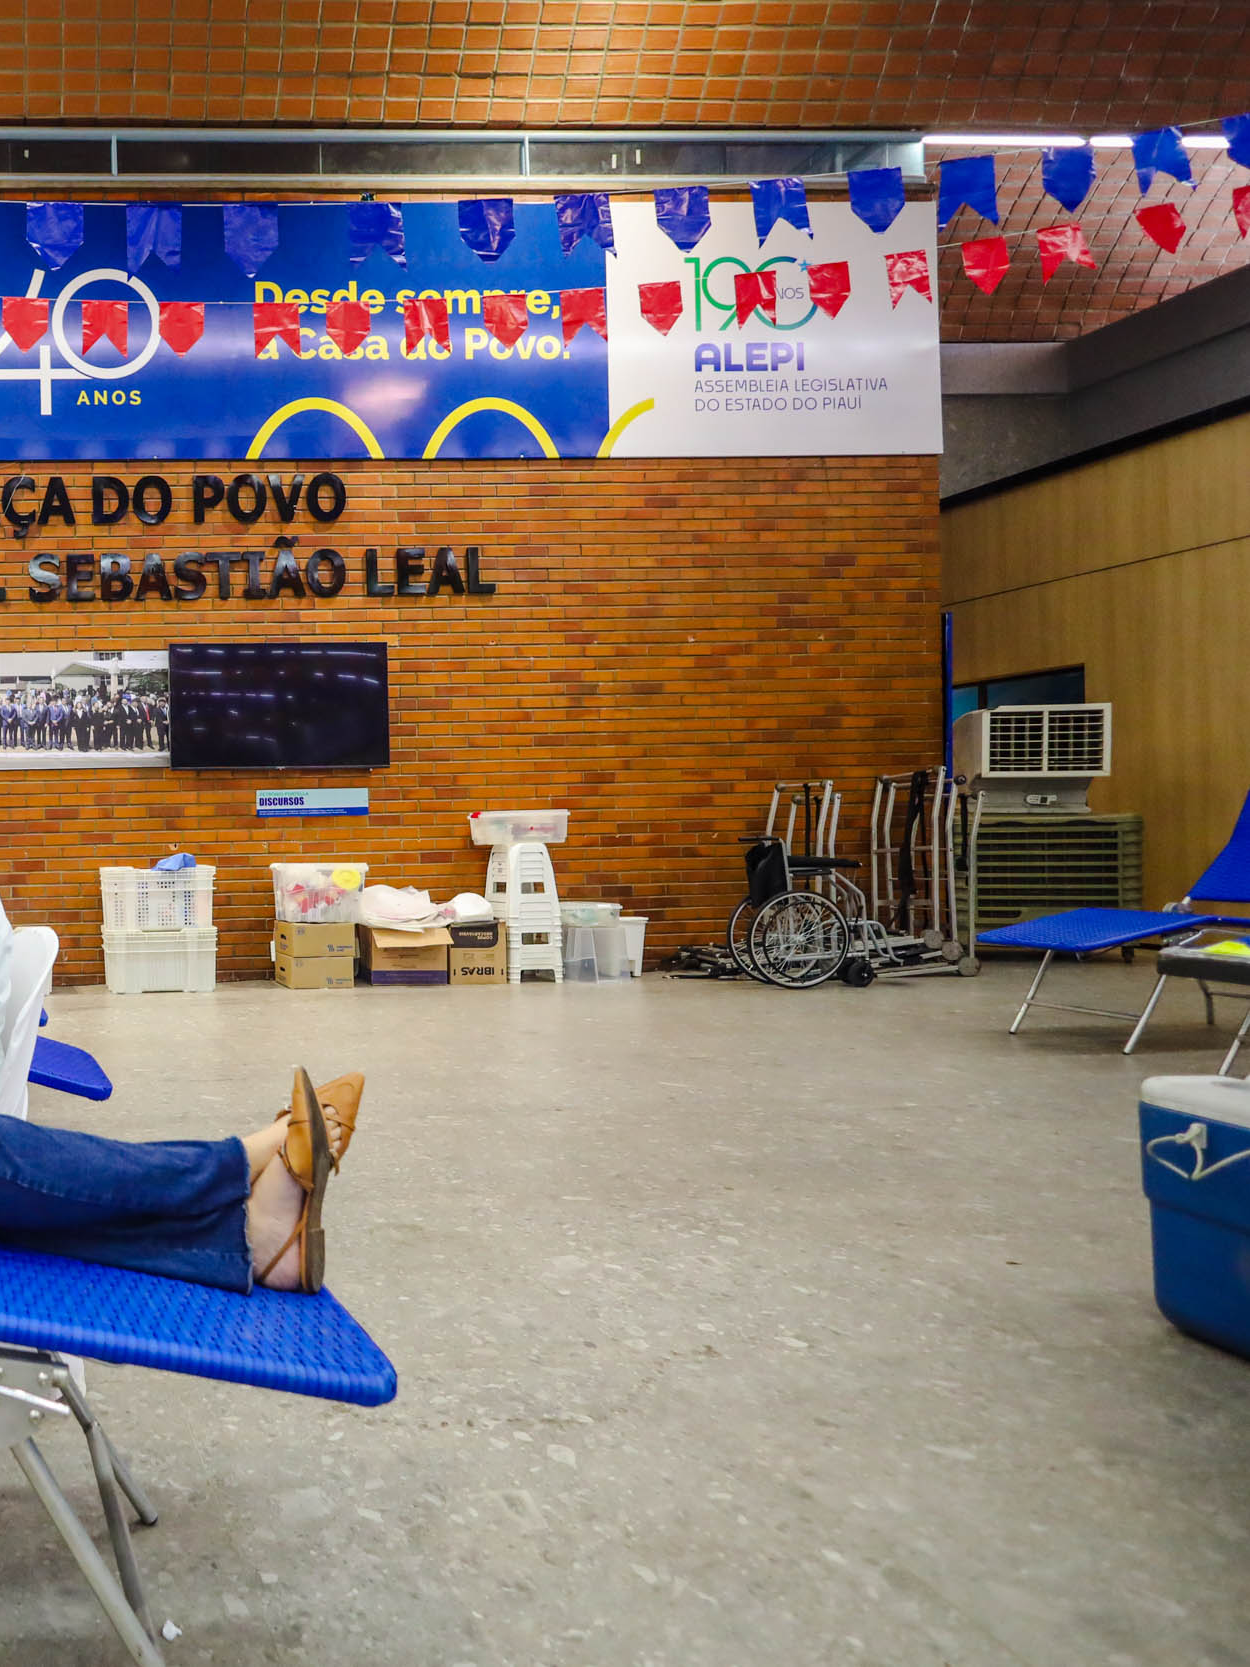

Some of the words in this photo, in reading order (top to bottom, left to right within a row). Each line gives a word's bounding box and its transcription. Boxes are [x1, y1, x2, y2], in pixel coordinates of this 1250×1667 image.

[464, 327, 571, 361] Povo.
[694, 341, 805, 372] ALEPI
[694, 379, 789, 393] ASSEMBLEIA
[794, 377, 888, 392] LEGISLATIVA
[76, 389, 142, 406] ANOS
[694, 398, 720, 412] DO
[725, 397, 788, 412] ESTADO
[792, 396, 817, 411] DO
[823, 394, 862, 411] PIAUÍ
[91, 474, 173, 526] DO
[192, 471, 348, 525] POVO
[28, 535, 347, 602] SEBASTIÃO
[365, 546, 498, 596] LEAL
[259, 796, 305, 807] DISCURSOS
[461, 966, 495, 976] IBRAS
